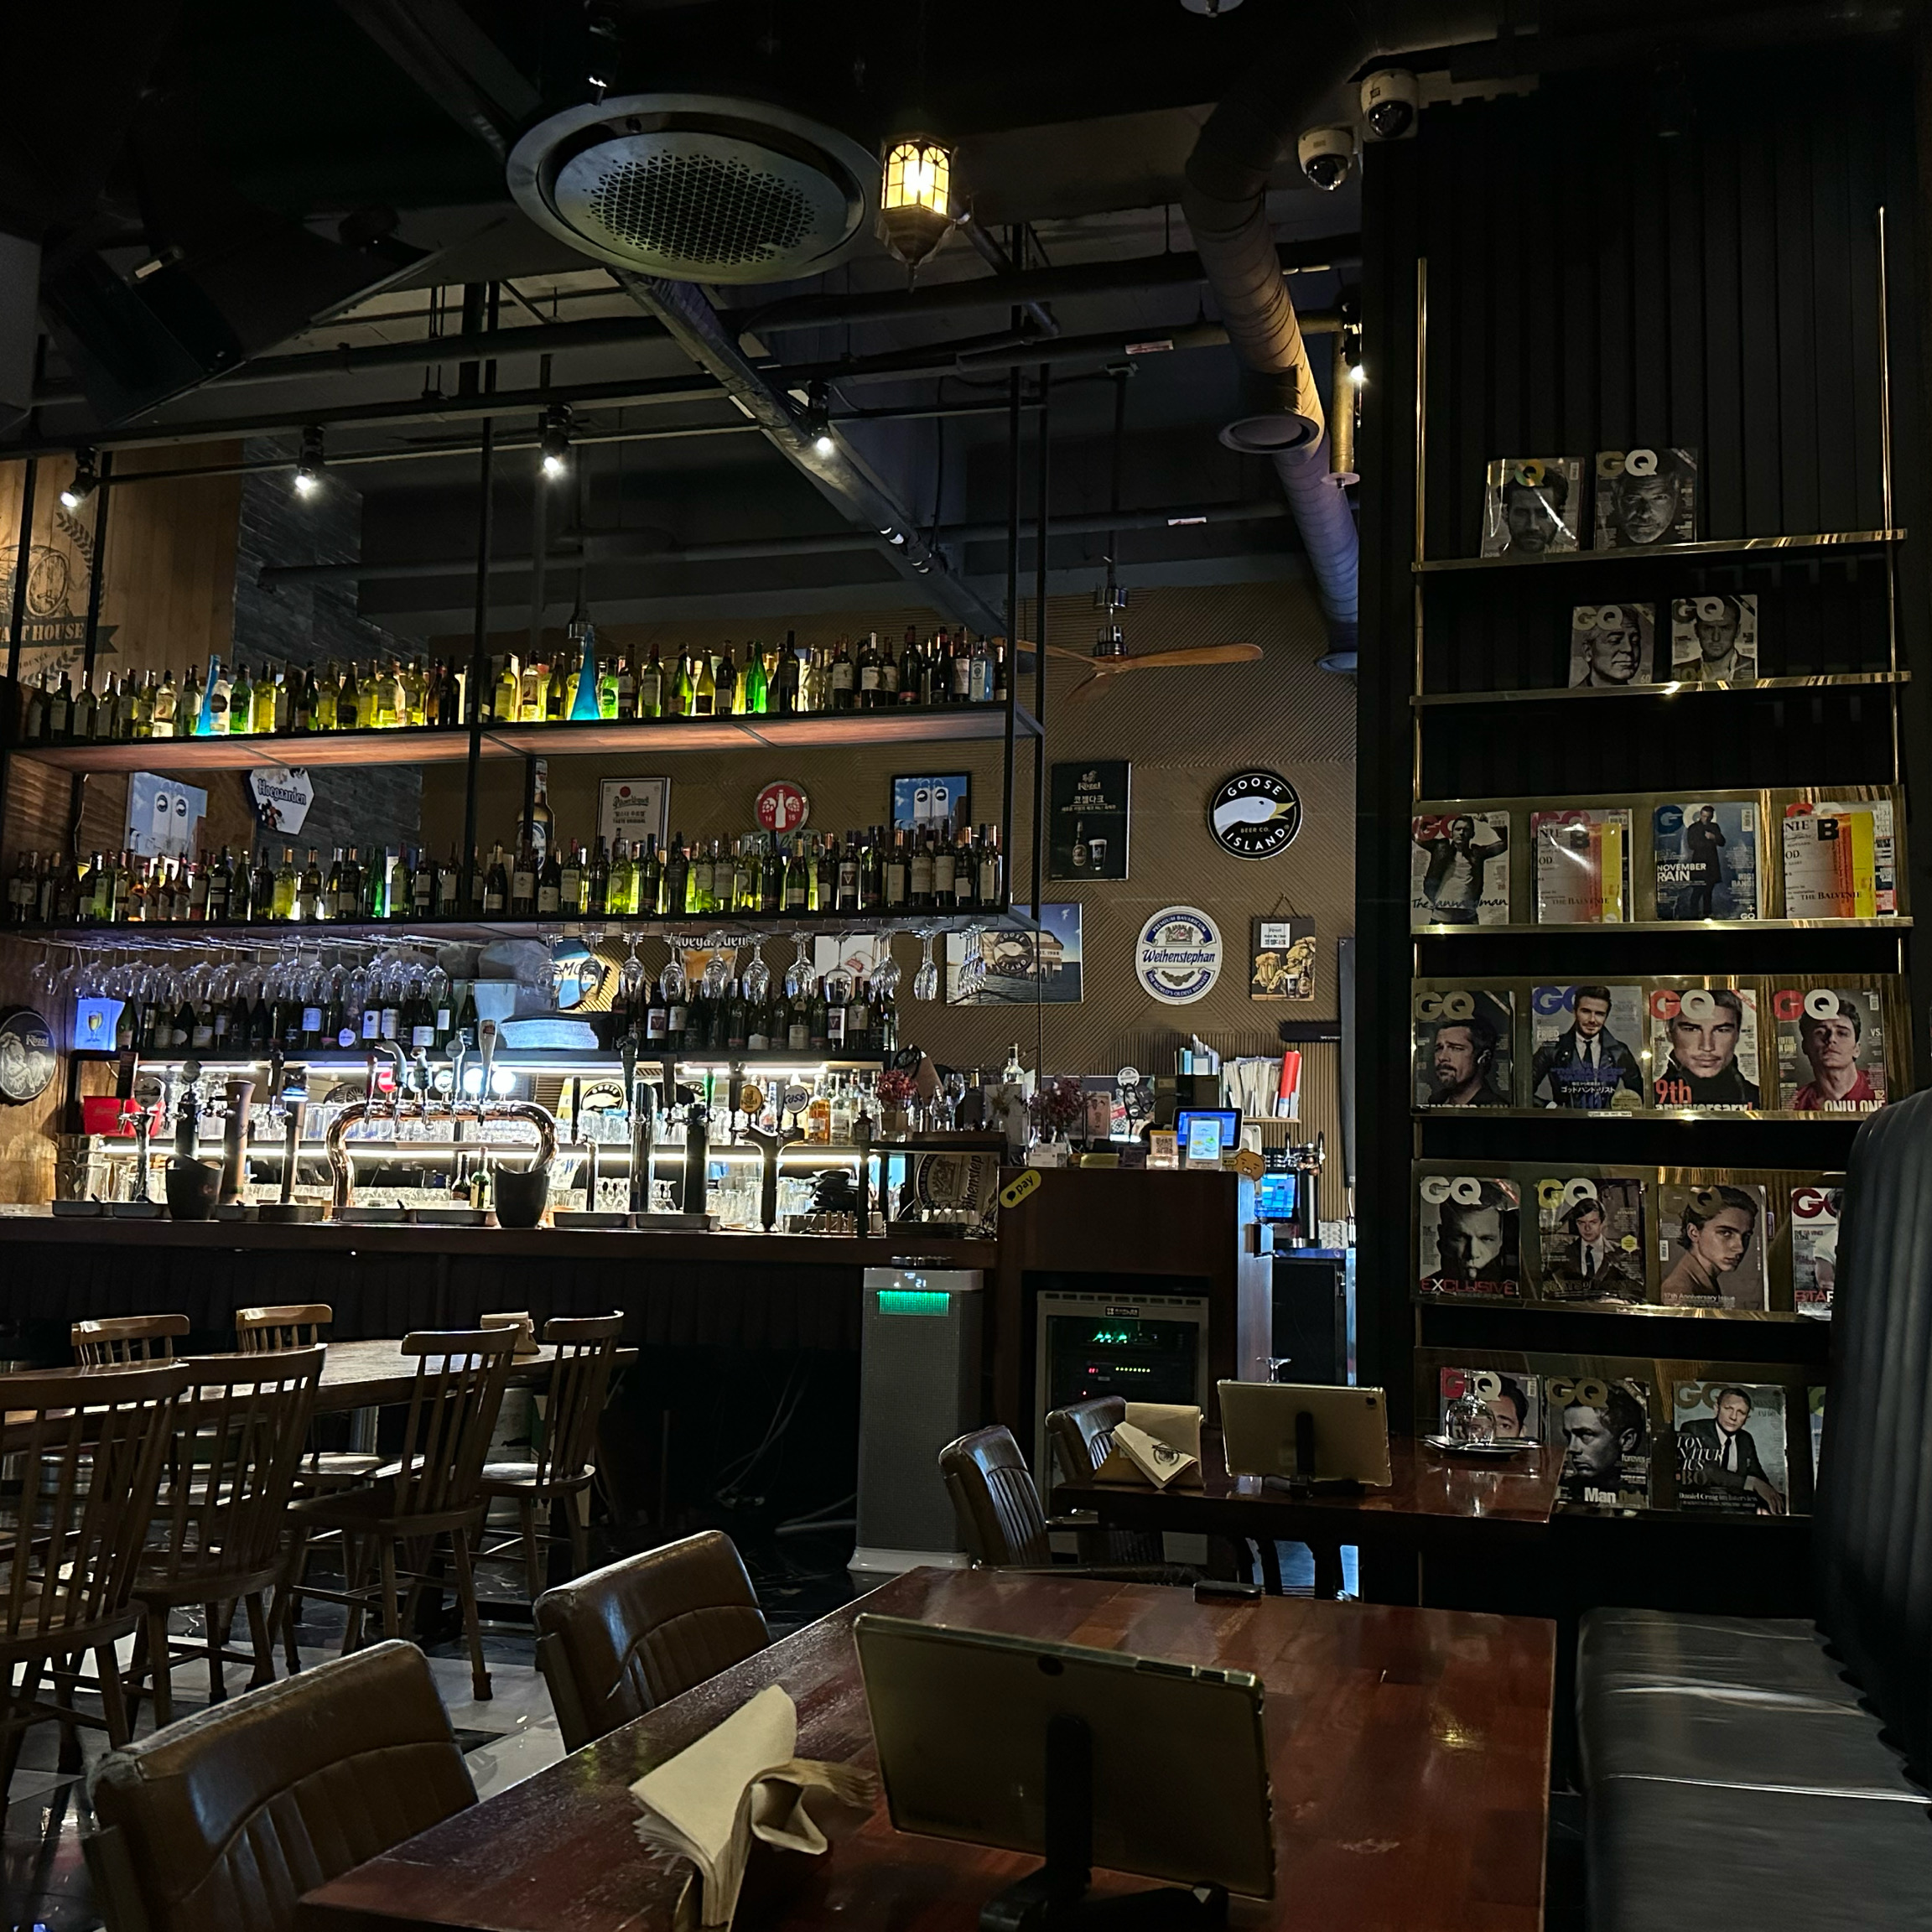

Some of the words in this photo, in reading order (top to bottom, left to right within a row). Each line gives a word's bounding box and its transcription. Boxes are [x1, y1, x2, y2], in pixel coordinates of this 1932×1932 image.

[1596, 449, 1657, 479] GQ
[1573, 605, 1622, 629] GQ
[1674, 596, 1726, 622] GQ
[32, 622, 84, 641] HOUSE
[257, 778, 307, 805] Hoegaarden
[1228, 777, 1282, 797] GOOSE
[1227, 828, 1285, 850] ISLAND
[1571, 829, 1590, 849] B
[1817, 818, 1839, 841] B
[1657, 862, 1707, 872] NOVEMBER
[1657, 870, 1690, 882] RAIN
[1000, 932, 1025, 942] GOOSE
[999, 958, 1026, 970] ISLAND
[1142, 948, 1216, 965] Weihenstephan
[1417, 991, 1475, 1021] GQ
[1650, 989, 1715, 1021] GQ
[1774, 989, 1840, 1021] GQ
[26, 1034, 49, 1047] Kozel
[1655, 1078, 1692, 1104] 9th
[1015, 1175, 1034, 1195] pay
[1420, 1176, 1482, 1206] GQ
[1538, 1177, 1597, 1209] GQ
[1420, 1278, 1520, 1296] EXCLUSIVE!
[1679, 1293, 1717, 1302] Anniversary
[1548, 1376, 1609, 1410] GQ
[1584, 1487, 1617, 1504] Man
